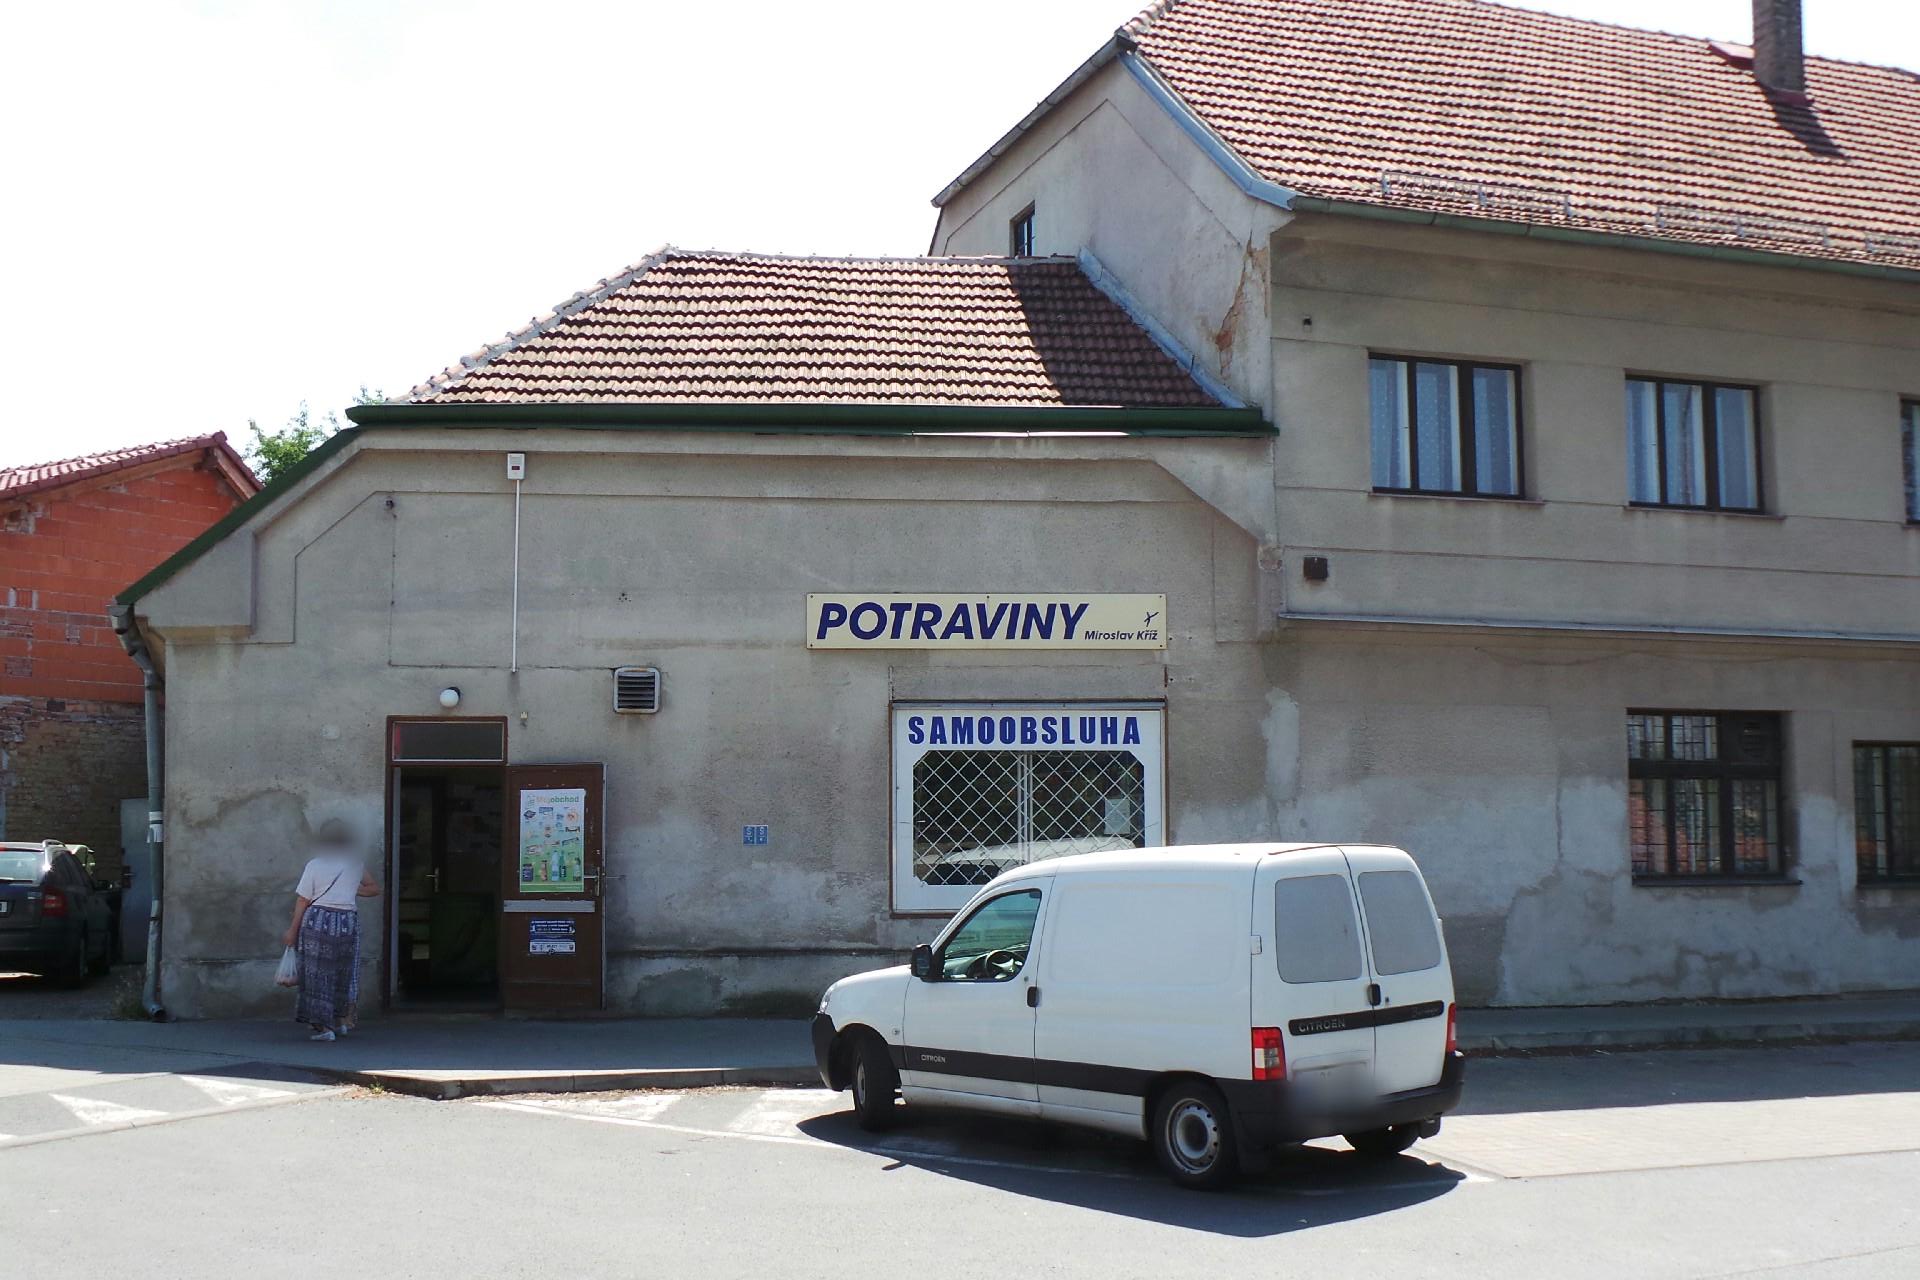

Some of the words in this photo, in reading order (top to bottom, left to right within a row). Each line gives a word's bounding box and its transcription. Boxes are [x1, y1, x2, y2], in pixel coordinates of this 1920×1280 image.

[816, 601, 1090, 641] POTRAVINY
[1084, 630, 1134, 641] Miroslav
[1136, 630, 1158, 641] Kříž
[908, 715, 1141, 745] SAMOOBSLUHA
